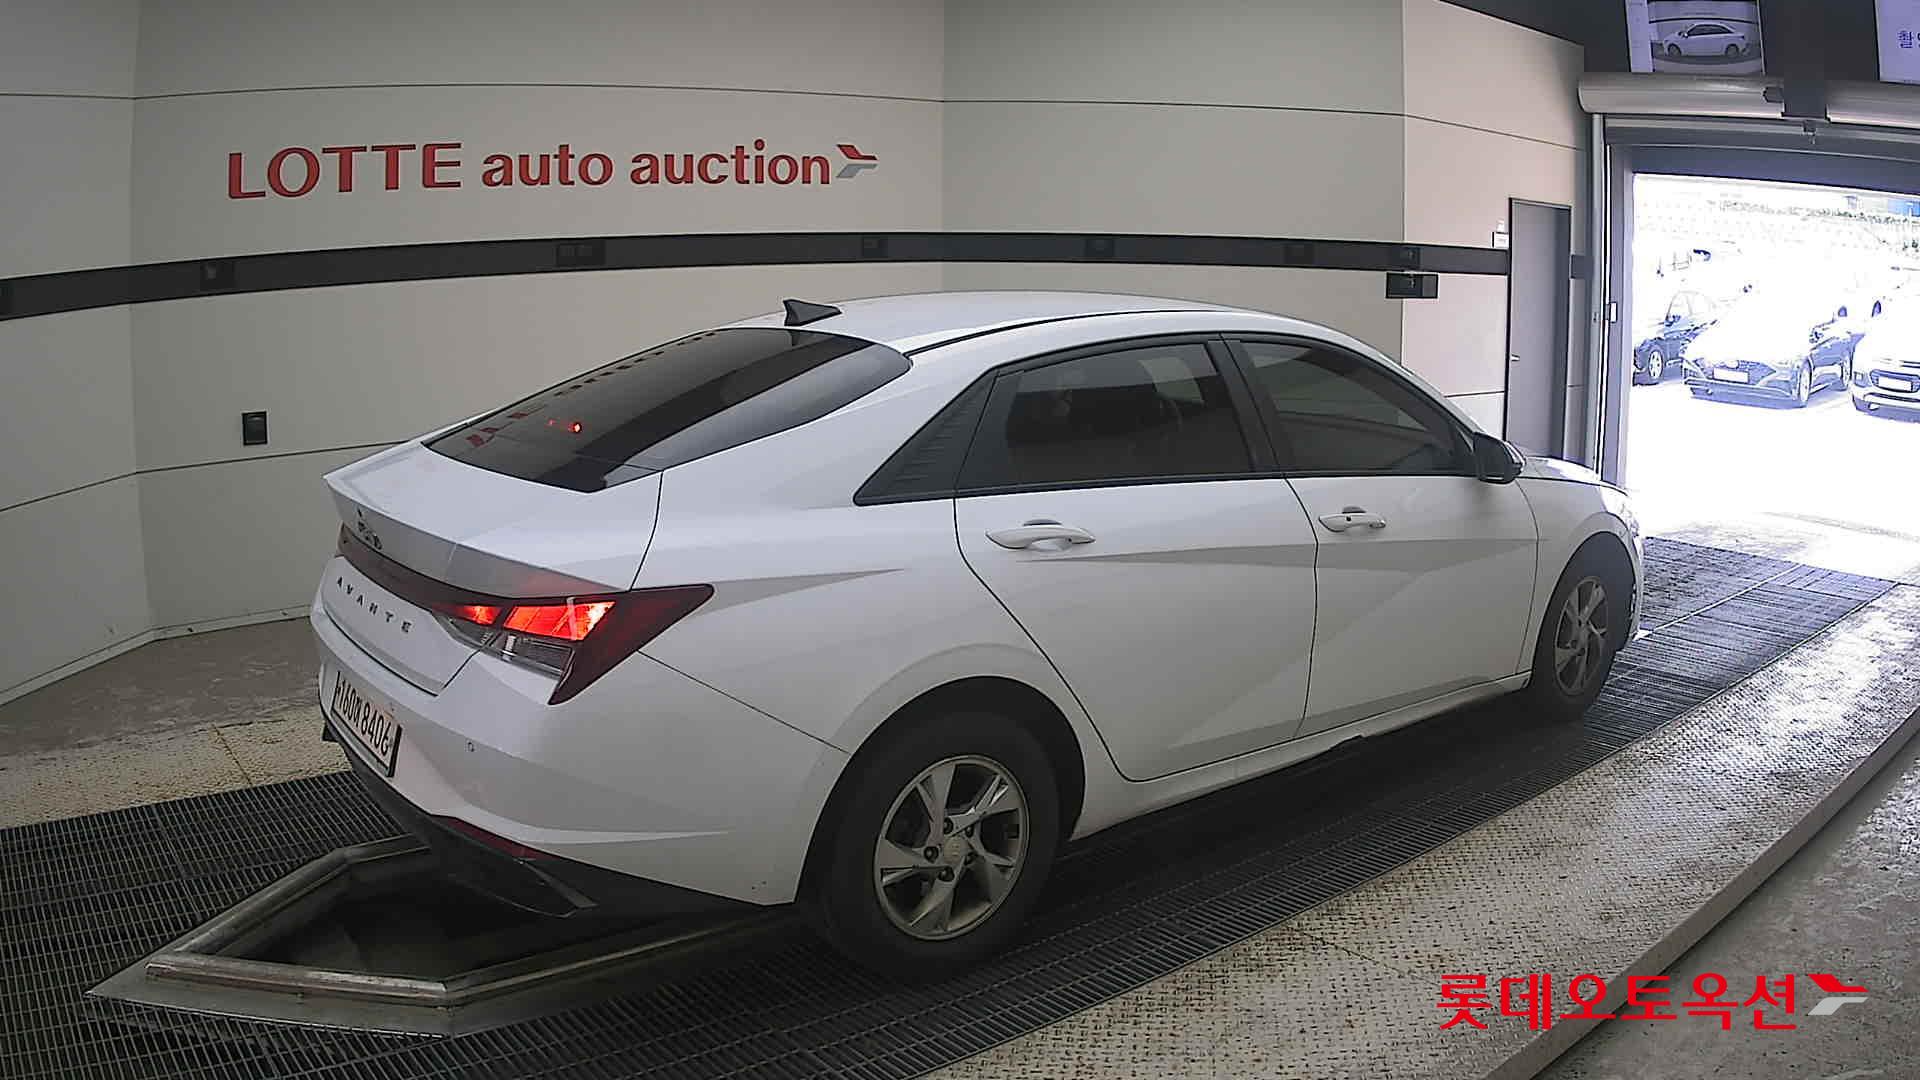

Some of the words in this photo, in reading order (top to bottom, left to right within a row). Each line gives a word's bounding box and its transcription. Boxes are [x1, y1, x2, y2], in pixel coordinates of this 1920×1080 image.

[1897, 31, 1920, 49] 촬
[228, 143, 462, 199] LOTTE
[482, 144, 613, 186] auto
[630, 139, 830, 185] auction
[337, 576, 412, 633] AVANTE
[361, 701, 391, 757] 8406
